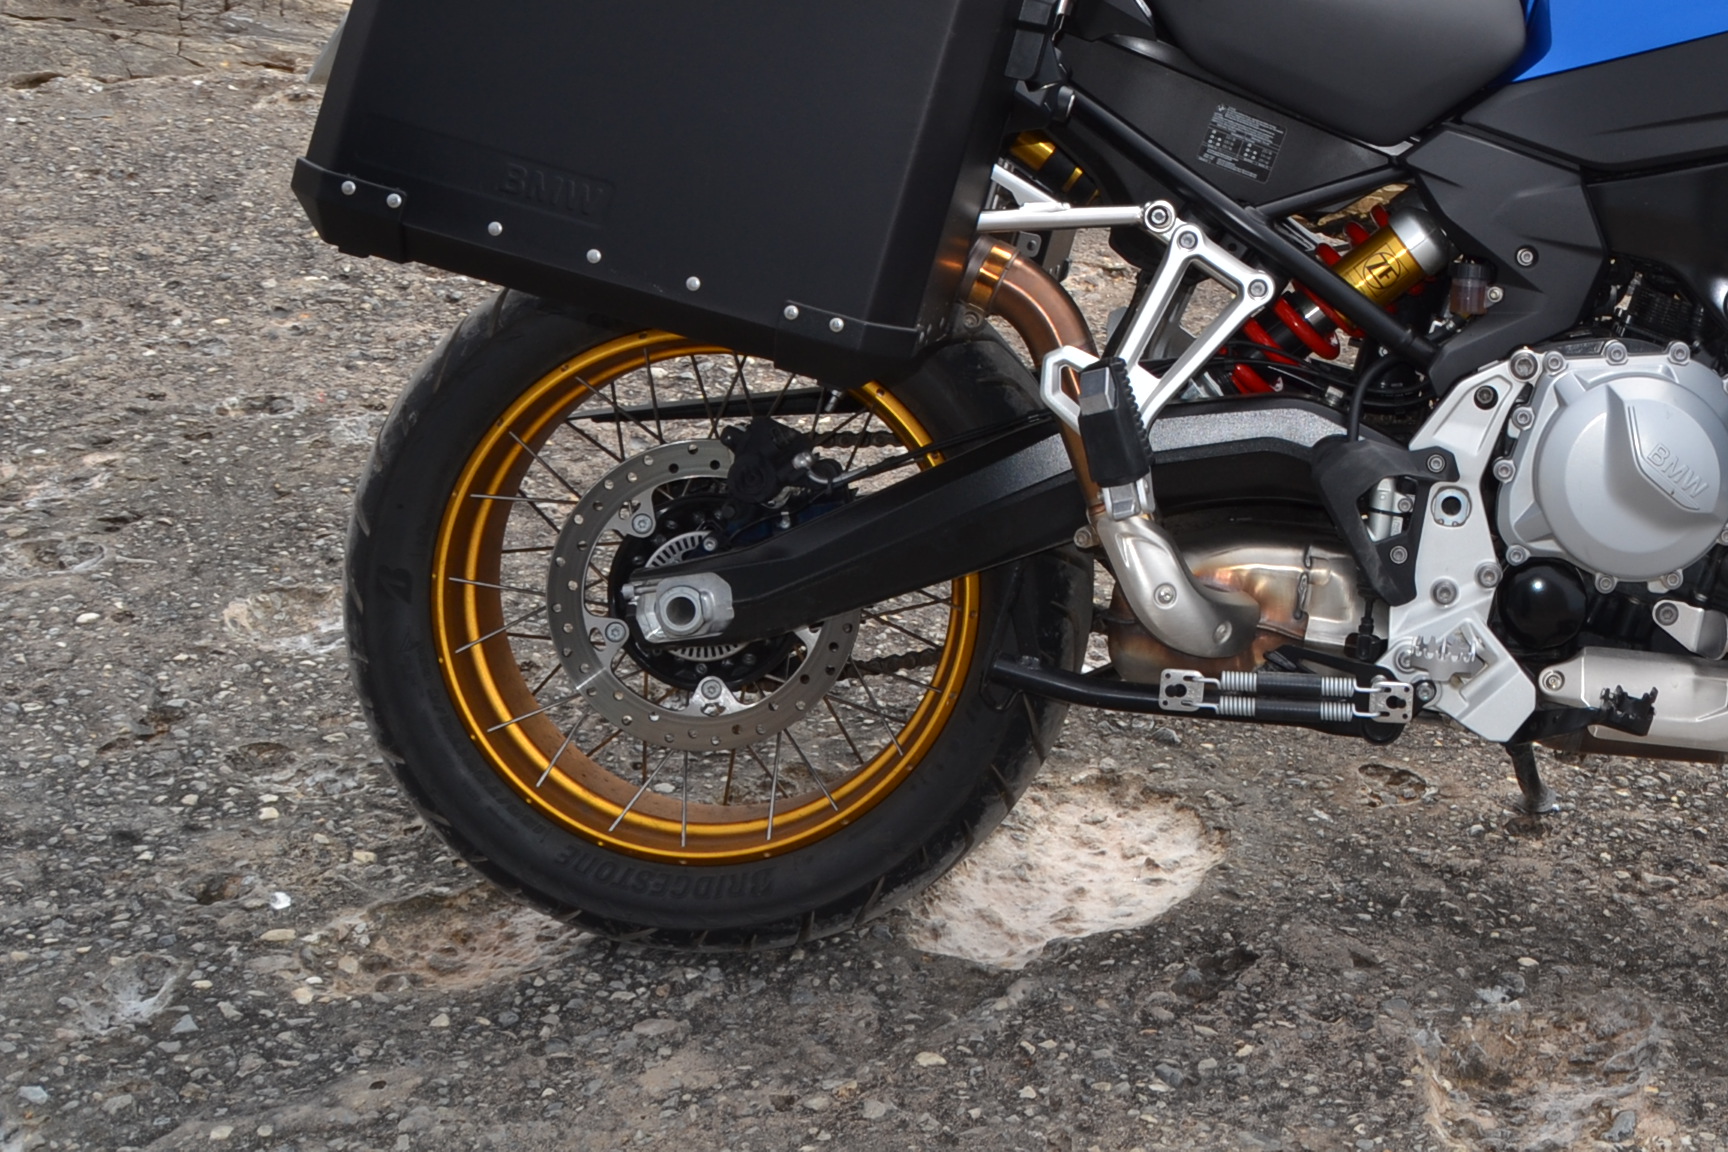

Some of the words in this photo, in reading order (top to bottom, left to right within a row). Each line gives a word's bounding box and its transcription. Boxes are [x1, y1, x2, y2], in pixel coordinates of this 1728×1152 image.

[497, 161, 606, 216] BMW
[1646, 442, 1710, 499] BMW
[552, 844, 777, 901] BRIDGESTONE
